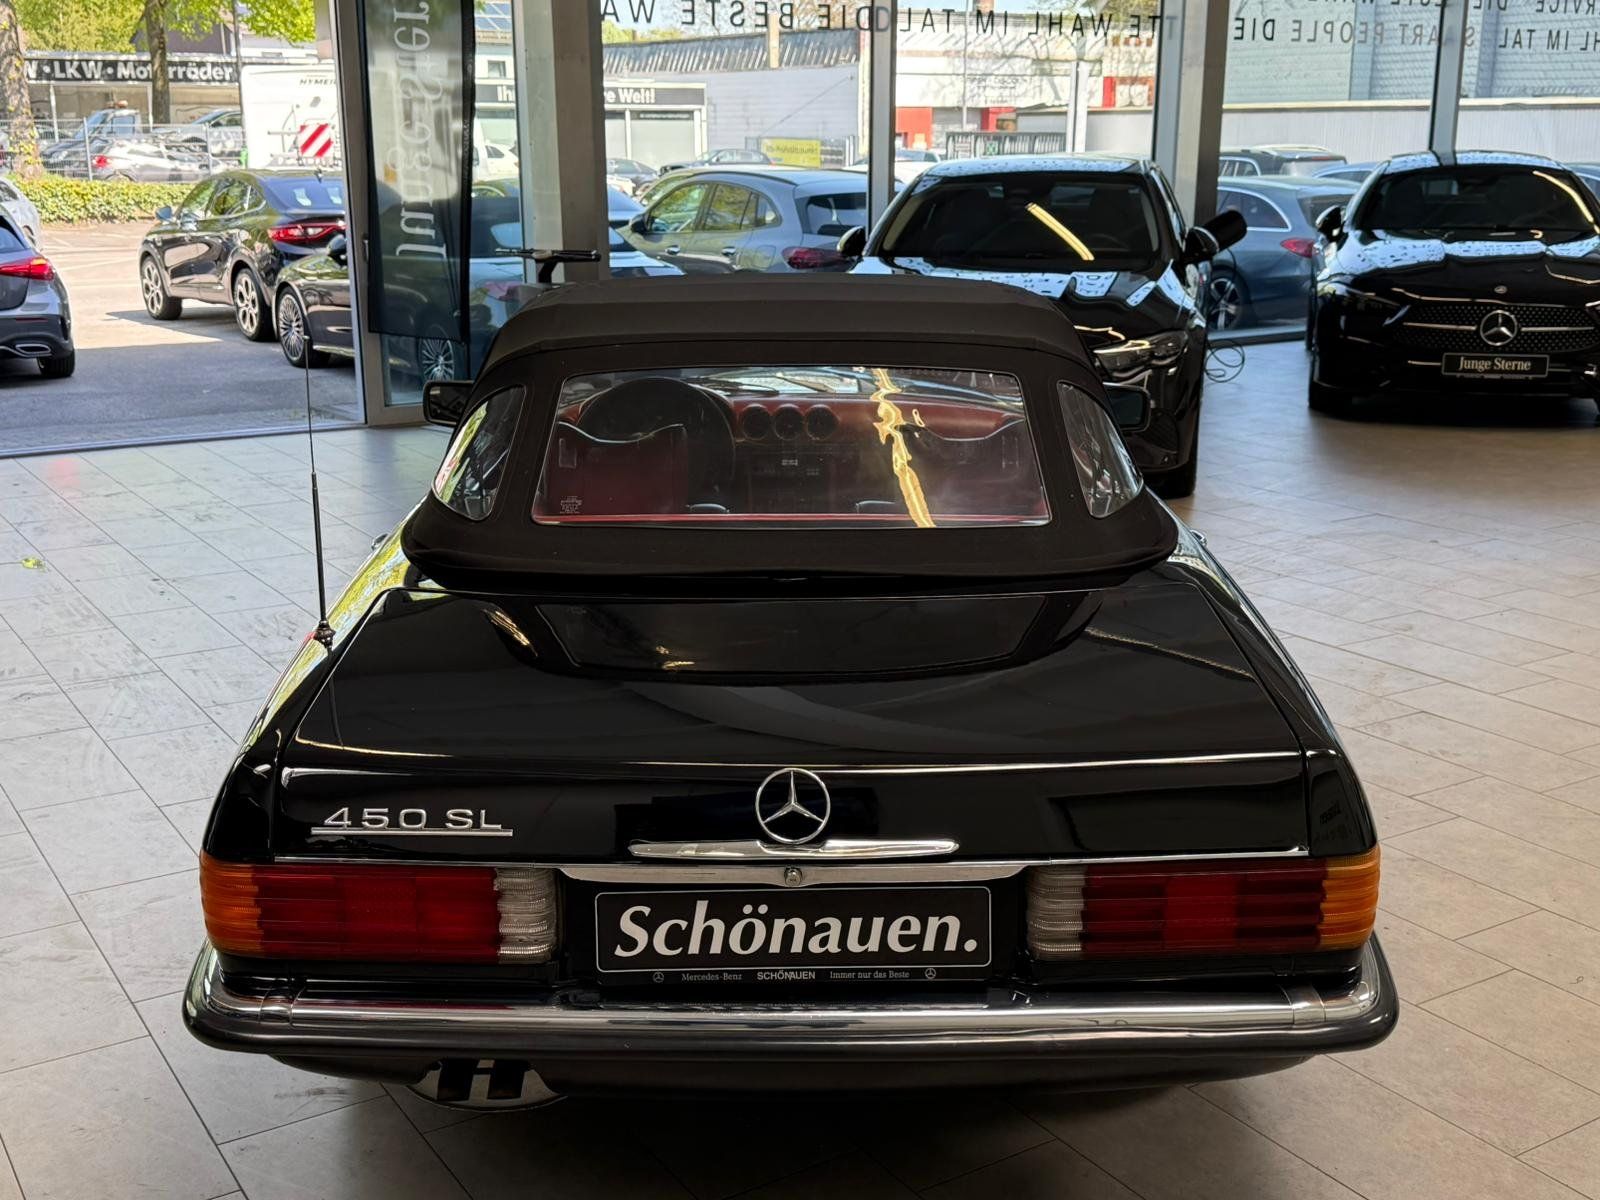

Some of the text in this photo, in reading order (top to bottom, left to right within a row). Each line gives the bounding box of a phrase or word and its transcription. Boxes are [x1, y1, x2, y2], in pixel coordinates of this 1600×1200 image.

[53, 60, 102, 79] LKW
[117, 61, 233, 81] Motrräder
[1459, 356, 1531, 372] Junge Sterne
[324, 808, 502, 829] 450 SL
[614, 900, 978, 958] Schönauen.
[681, 969, 910, 981] Mercedes-Benz SCHÖNAUEN Immer nur das Beste
